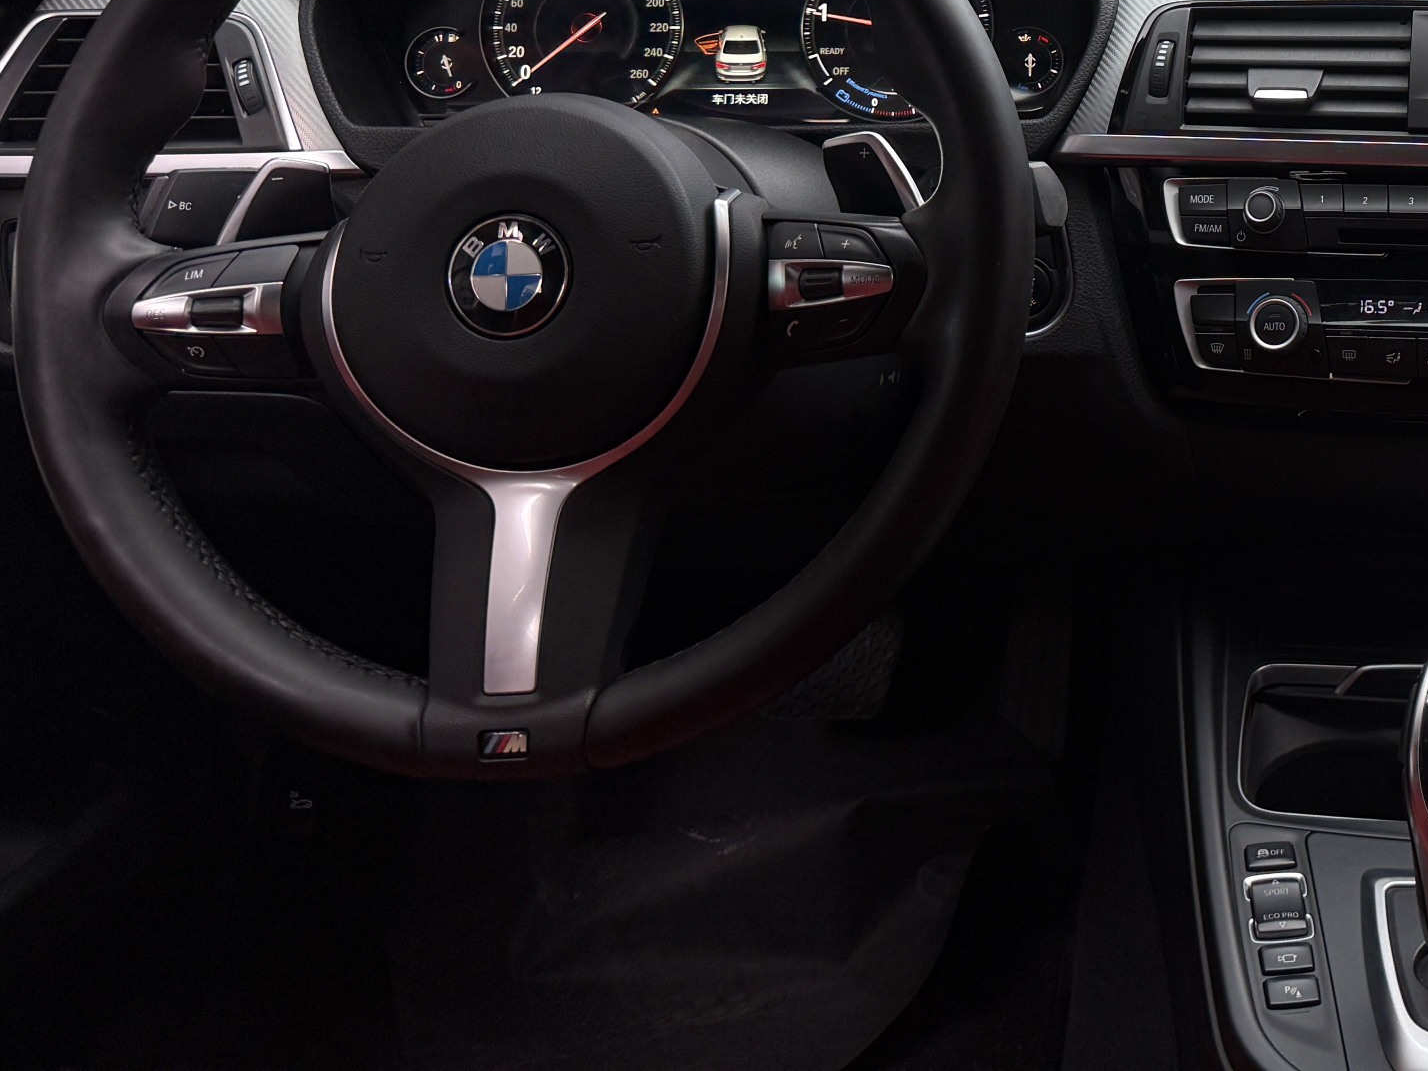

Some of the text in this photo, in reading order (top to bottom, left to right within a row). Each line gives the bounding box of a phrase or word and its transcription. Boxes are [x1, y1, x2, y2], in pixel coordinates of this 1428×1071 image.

[817, 3, 828, 22] 1
[504, 23, 518, 33] 40
[650, 22, 669, 32] 220
[508, 46, 525, 58] 20
[644, 47, 663, 57] 240
[820, 47, 845, 55] READY
[520, 64, 531, 79] 0
[630, 69, 649, 79] 260
[833, 67, 850, 76] OFF
[455, 81, 462, 89] 0
[711, 94, 769, 105] 车门未关闭
[871, 98, 878, 107] 0
[1190, 195, 1214, 204] MODE
[1362, 197, 1368, 205] 2
[1408, 197, 1414, 205] 3
[179, 201, 192, 211] BC
[1194, 224, 1222, 233] FM/AM
[462, 221, 556, 258] BMW
[184, 269, 204, 280] LIM
[1263, 322, 1286, 331] AUTO
[1263, 887, 1289, 896] SPORT
[1263, 913, 1280, 921] ECO
